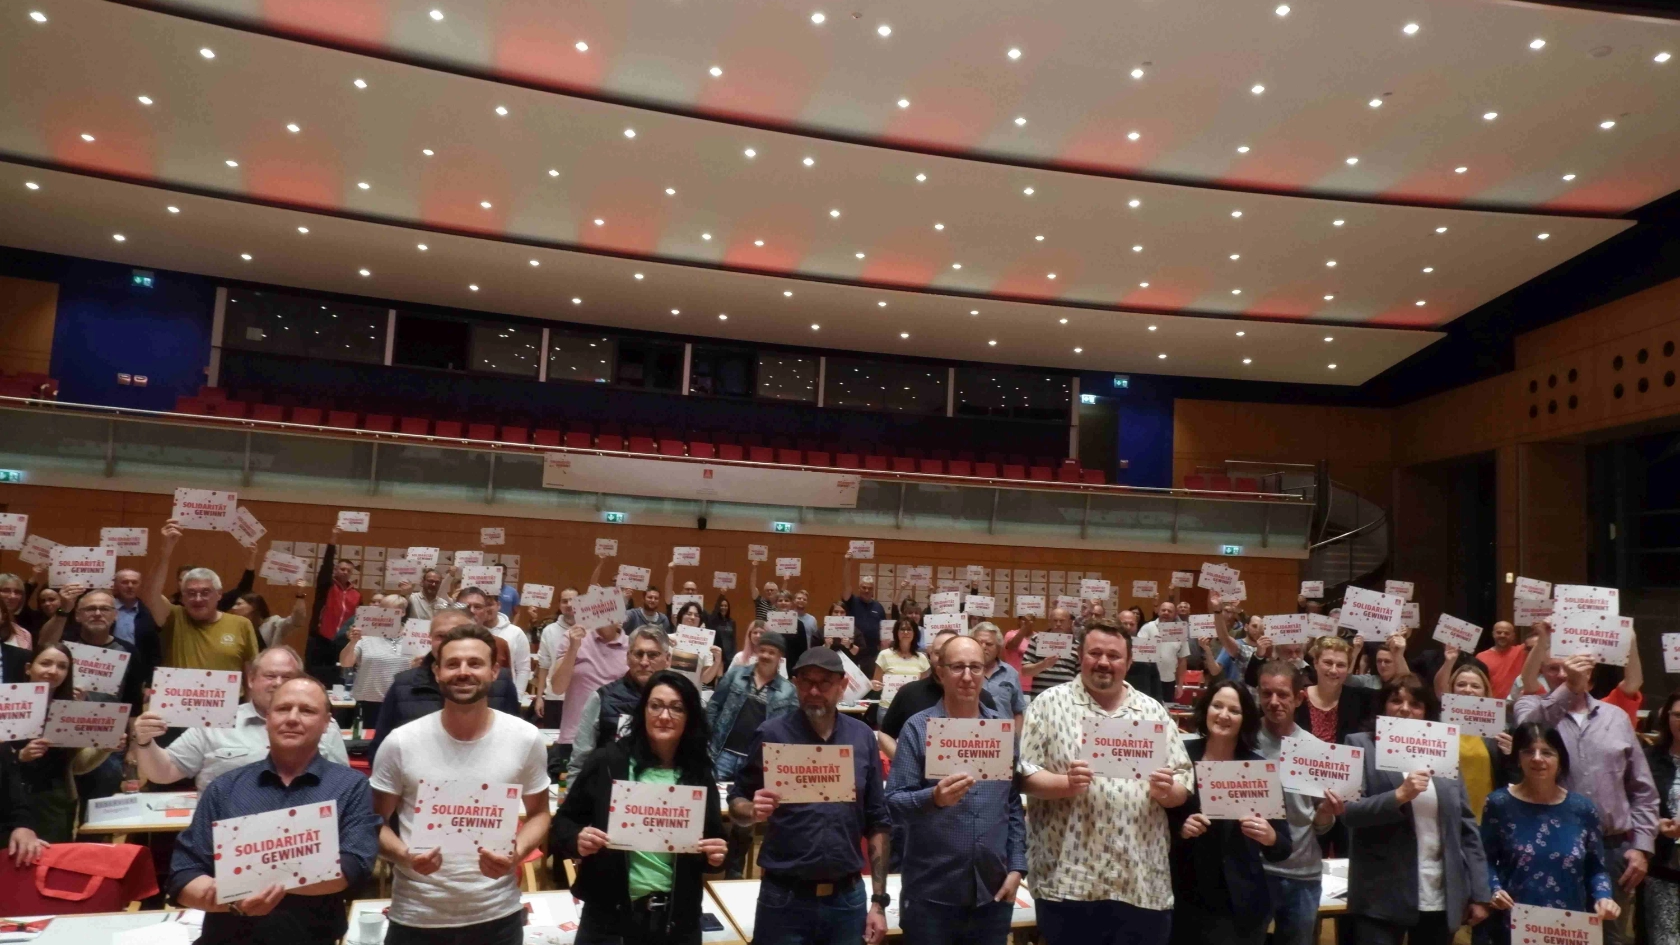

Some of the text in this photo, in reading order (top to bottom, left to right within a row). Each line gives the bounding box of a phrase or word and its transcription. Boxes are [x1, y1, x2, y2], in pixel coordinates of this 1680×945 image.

[182, 502, 226, 510] SOLIDARITÄT
[1564, 597, 1609, 605] SOLIDARITÄT
[1352, 601, 1394, 615] SOLIDARITÄT
[1363, 611, 1392, 621] GEWINNT
[1563, 627, 1620, 639] SOLIDARITÄT
[1579, 637, 1619, 647] GEWINNT
[73, 658, 115, 670] OLIDARITÄT
[78, 667, 113, 678] GEWINNT
[164, 688, 227, 699] SOLIDARITÄT
[181, 698, 225, 708] GEWINNT
[1451, 708, 1496, 717] SOLIDARITÄT
[60, 716, 116, 725] SOLIDARITÄT
[1464, 716, 1496, 724] GEWINNT
[940, 738, 1001, 749] SOLIDARITÄT
[1094, 737, 1154, 749] SOLIDARITÄT
[1389, 734, 1447, 749] SOLIDARITÄT
[957, 749, 1001, 758] GEWINNT
[1112, 748, 1154, 758] GEWINNT
[1406, 745, 1447, 757] GEWINNT
[776, 764, 840, 774] SOLIDARITÄT
[1292, 756, 1350, 772] SOLIDARITÄT
[795, 774, 841, 784] GEWINNT
[1309, 768, 1350, 781] GEWINNT
[1210, 779, 1268, 790] SOLIDARITÄT
[1228, 789, 1270, 798] GEWINNT
[431, 805, 504, 818] SOLIDARITÄT
[625, 805, 690, 818] SOLIDARITÄT
[451, 816, 503, 829] GEWINNT
[643, 817, 690, 829] GEWINNT
[235, 829, 320, 857] SOLIDARITÄT
[262, 843, 321, 864] GEWINNT
[1525, 924, 1589, 940] SOLIDARITÄT
